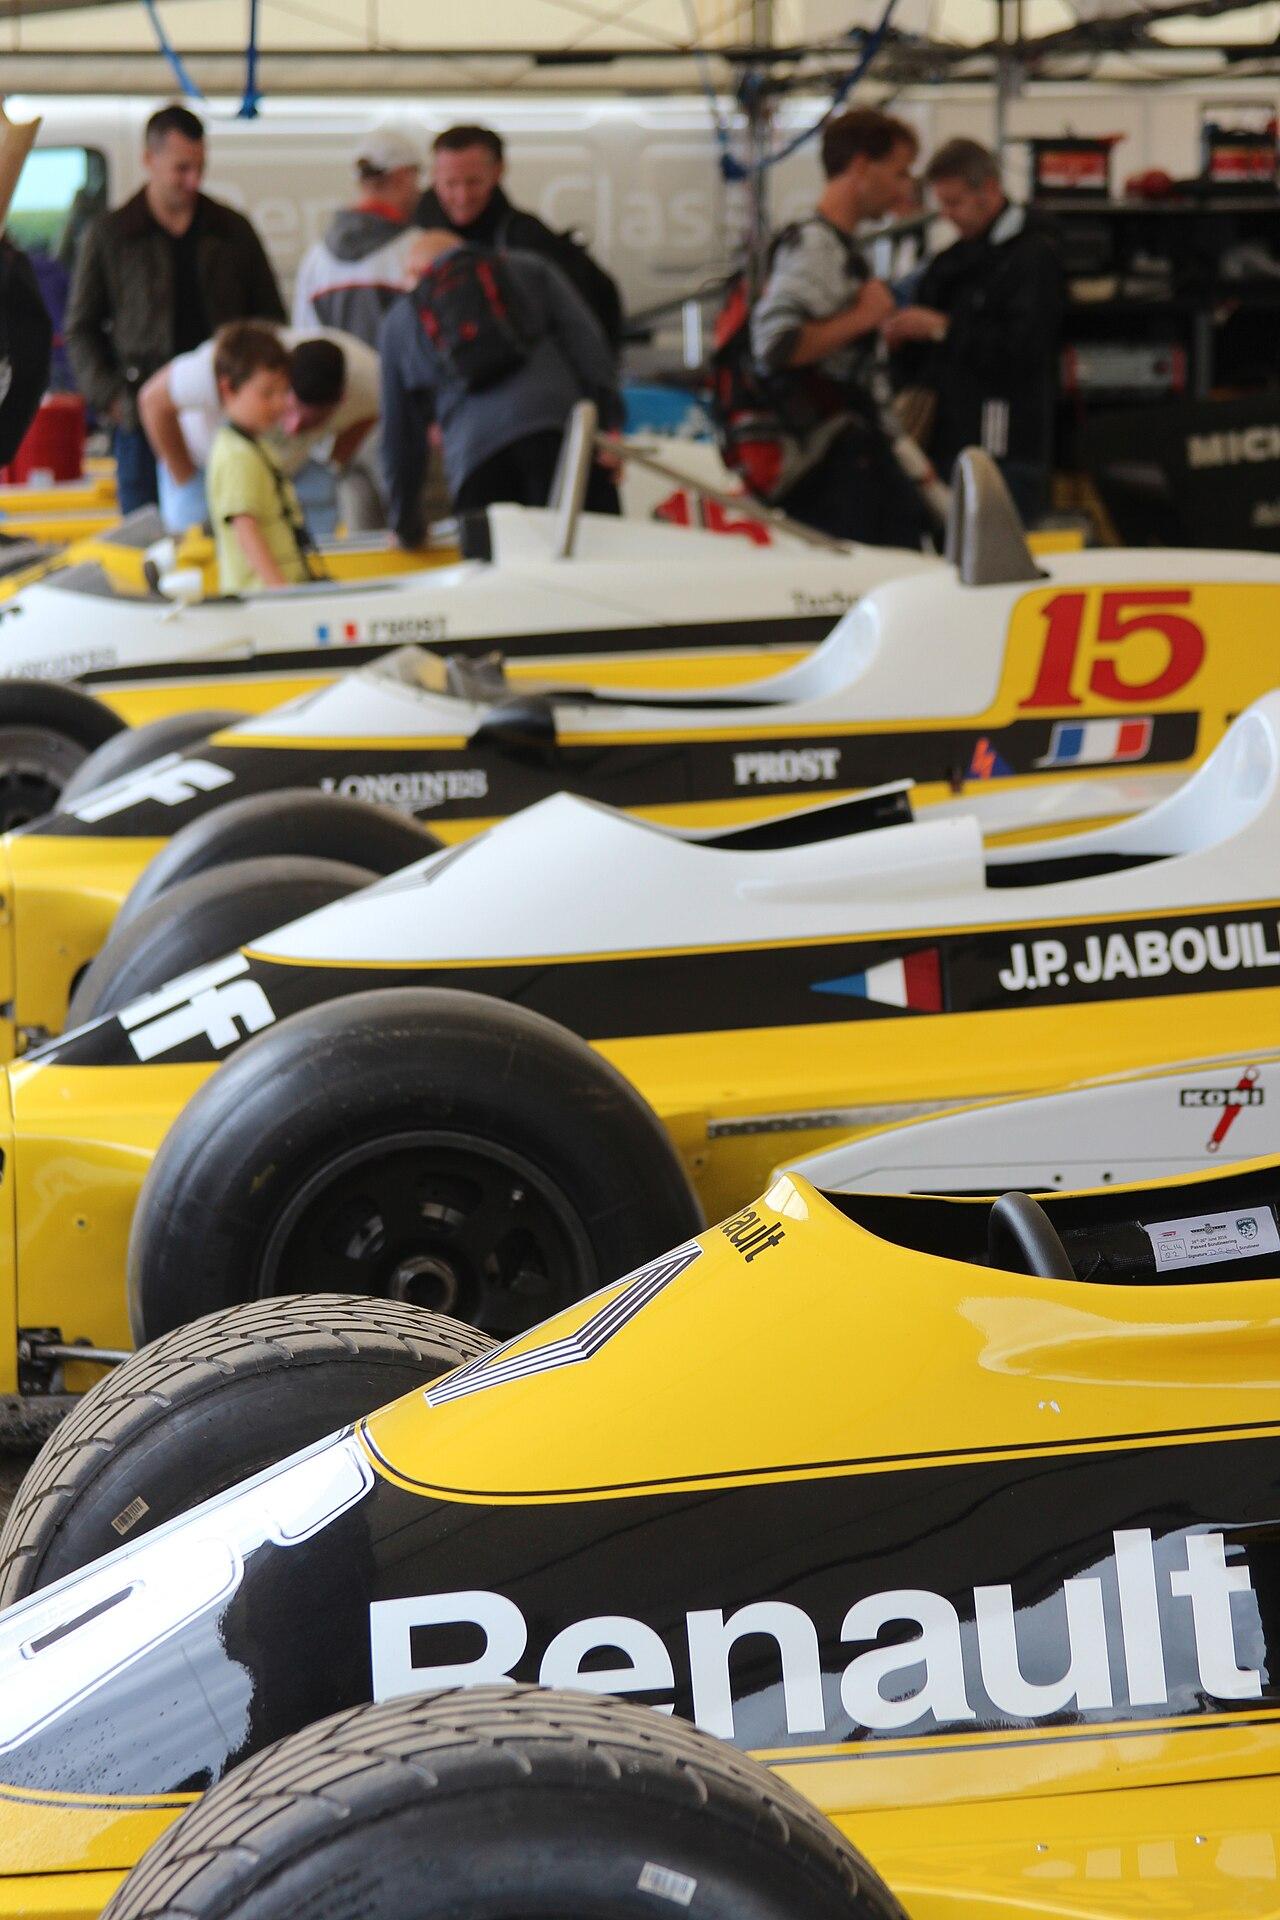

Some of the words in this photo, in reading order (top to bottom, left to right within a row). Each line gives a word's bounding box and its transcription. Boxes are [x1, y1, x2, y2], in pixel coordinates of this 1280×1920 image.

[1017, 589, 1208, 710] 15
[733, 748, 841, 785] PROST
[998, 940, 1070, 990] J.P.
[1073, 921, 1280, 984] JABOUIL
[1179, 1087, 1265, 1108] KONI
[721, 1206, 786, 1263] ault
[370, 1527, 1263, 1740] Renault
